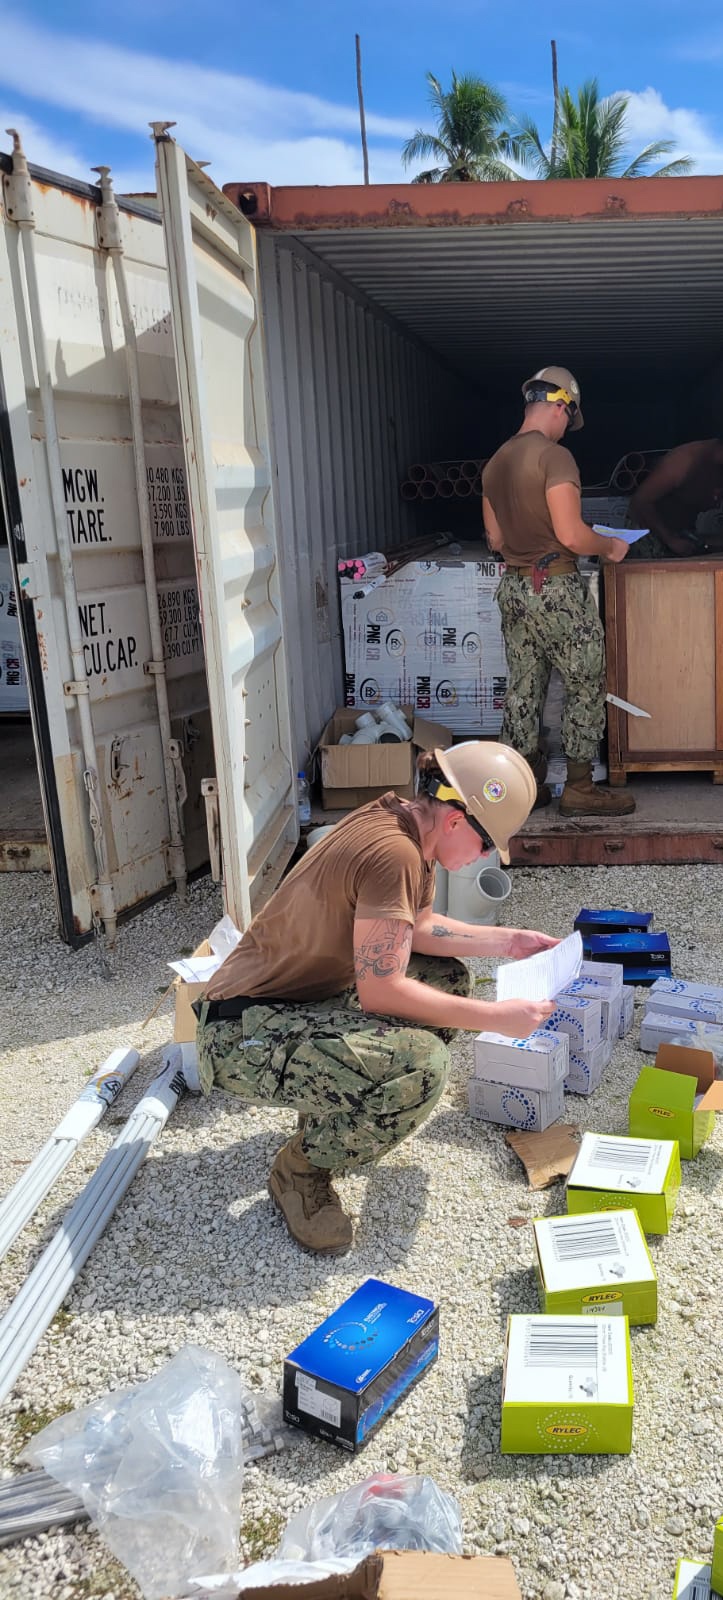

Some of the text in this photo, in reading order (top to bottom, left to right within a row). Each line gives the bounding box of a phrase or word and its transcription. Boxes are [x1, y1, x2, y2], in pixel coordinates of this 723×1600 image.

[62, 468, 105, 503] MGW.
[146, 467, 184, 484] 0.480 KGS
[173, 486, 186, 501] LBS
[153, 503, 188, 519] 3.590 KGS
[67, 509, 112, 544] TARE.
[154, 520, 190, 537] 7.900 LBS
[183, 588, 195, 605] KGS
[78, 602, 112, 637] NET.
[184, 605, 197, 622] LBS
[366, 624, 380, 660] PNG CR
[442, 627, 457, 664] PNG CR
[83, 636, 138, 677] CU.CAP.
[416, 676, 431, 709] PNG CR
[492, 676, 507, 697] PNG
[588, 1293, 618, 1302] RYLEC
